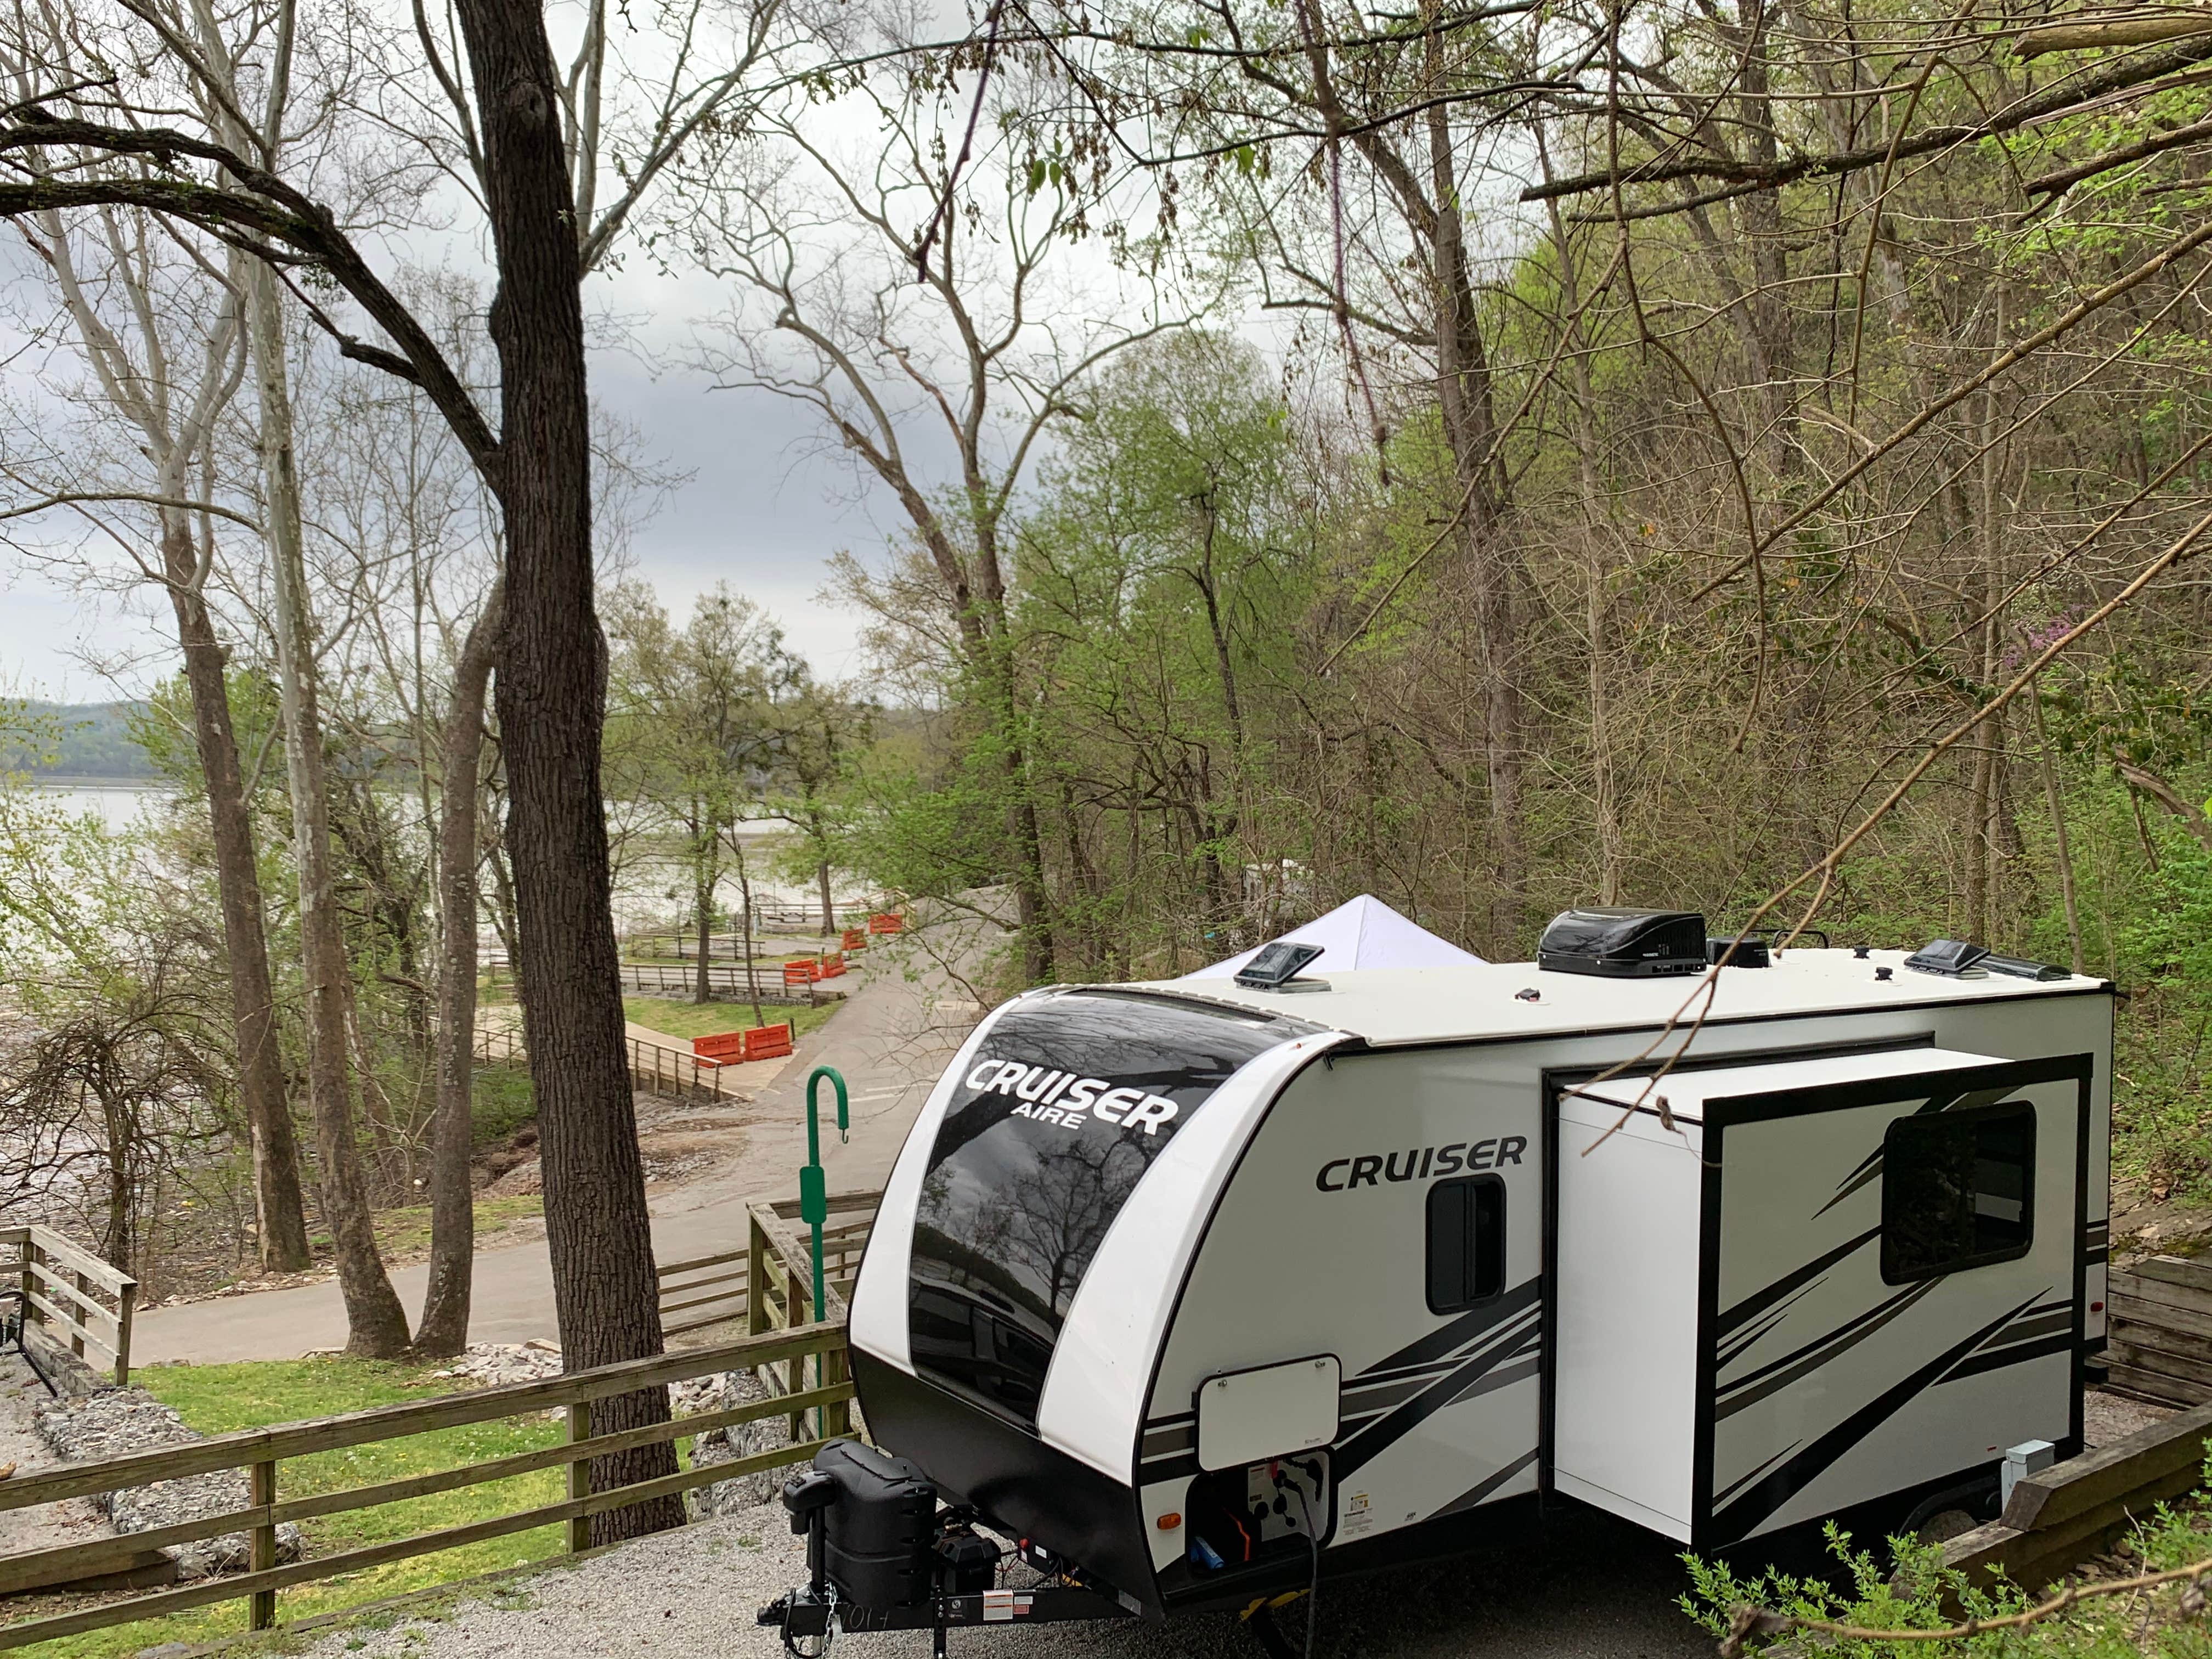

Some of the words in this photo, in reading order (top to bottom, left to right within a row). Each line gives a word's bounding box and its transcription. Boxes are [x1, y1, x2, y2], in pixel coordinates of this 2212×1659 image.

[965, 1059, 1178, 1135] CRUISER
[1011, 1102, 1087, 1130] AIRE
[1316, 1136, 1528, 1193] CRUISER
